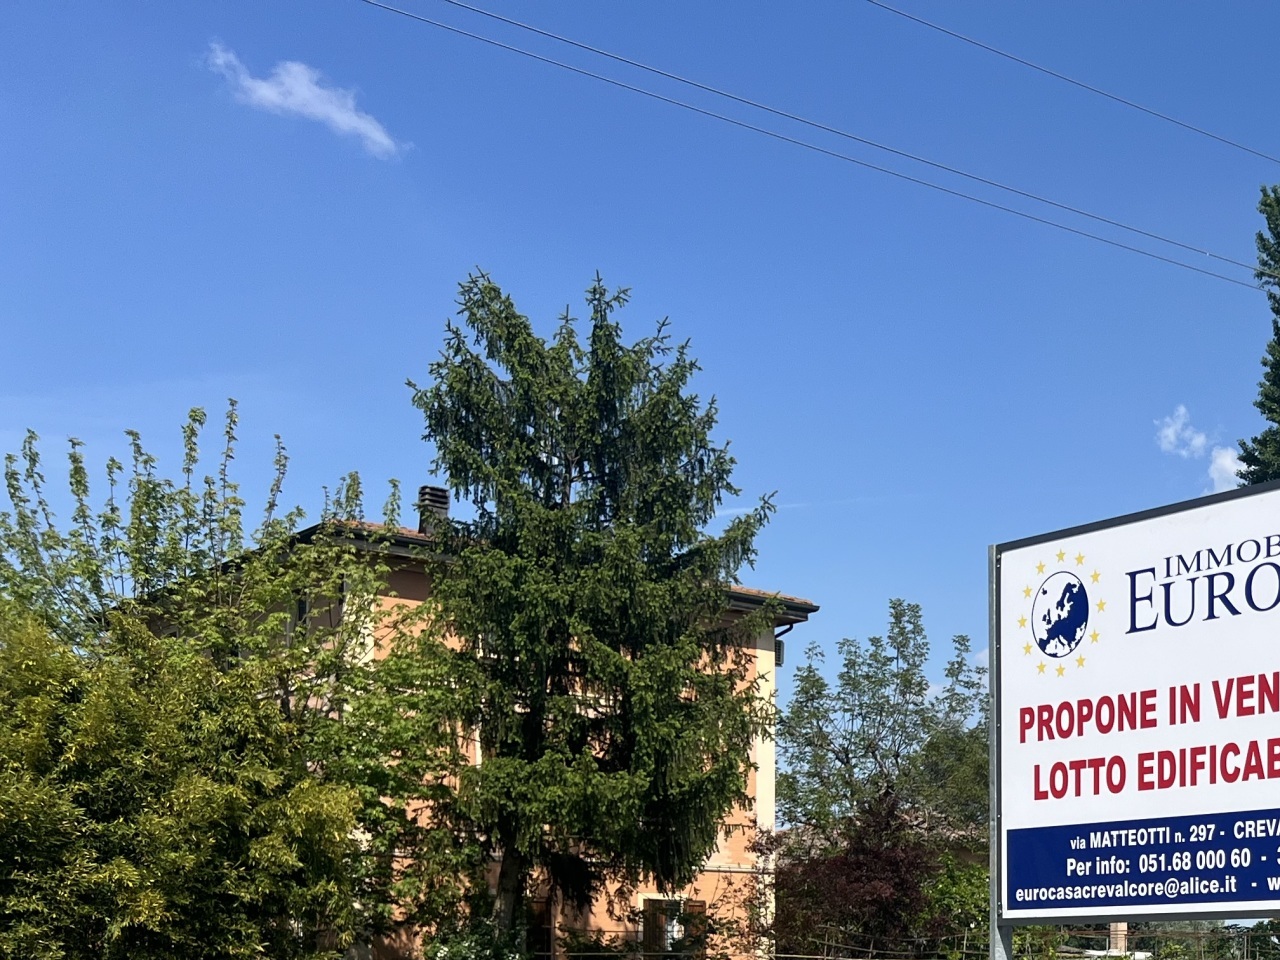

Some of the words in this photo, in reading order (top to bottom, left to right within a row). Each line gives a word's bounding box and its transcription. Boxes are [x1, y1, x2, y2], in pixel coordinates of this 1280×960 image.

[1020, 690, 1157, 742] PROPONE
[1170, 684, 1200, 724] IN
[1035, 756, 1126, 800] LOTTO
[1069, 836, 1087, 850] via
[1090, 827, 1169, 848] MATTEOTTI
[1174, 831, 1186, 843] n.
[1190, 824, 1215, 841] 297
[1067, 858, 1091, 876] Per
[1096, 856, 1129, 874] info:
[1139, 852, 1191, 873] 051.68
[1196, 850, 1225, 869] 000
[1231, 848, 1250, 867] 60
[1016, 875, 1236, 901] eurocasacrevalcore@alice.it
